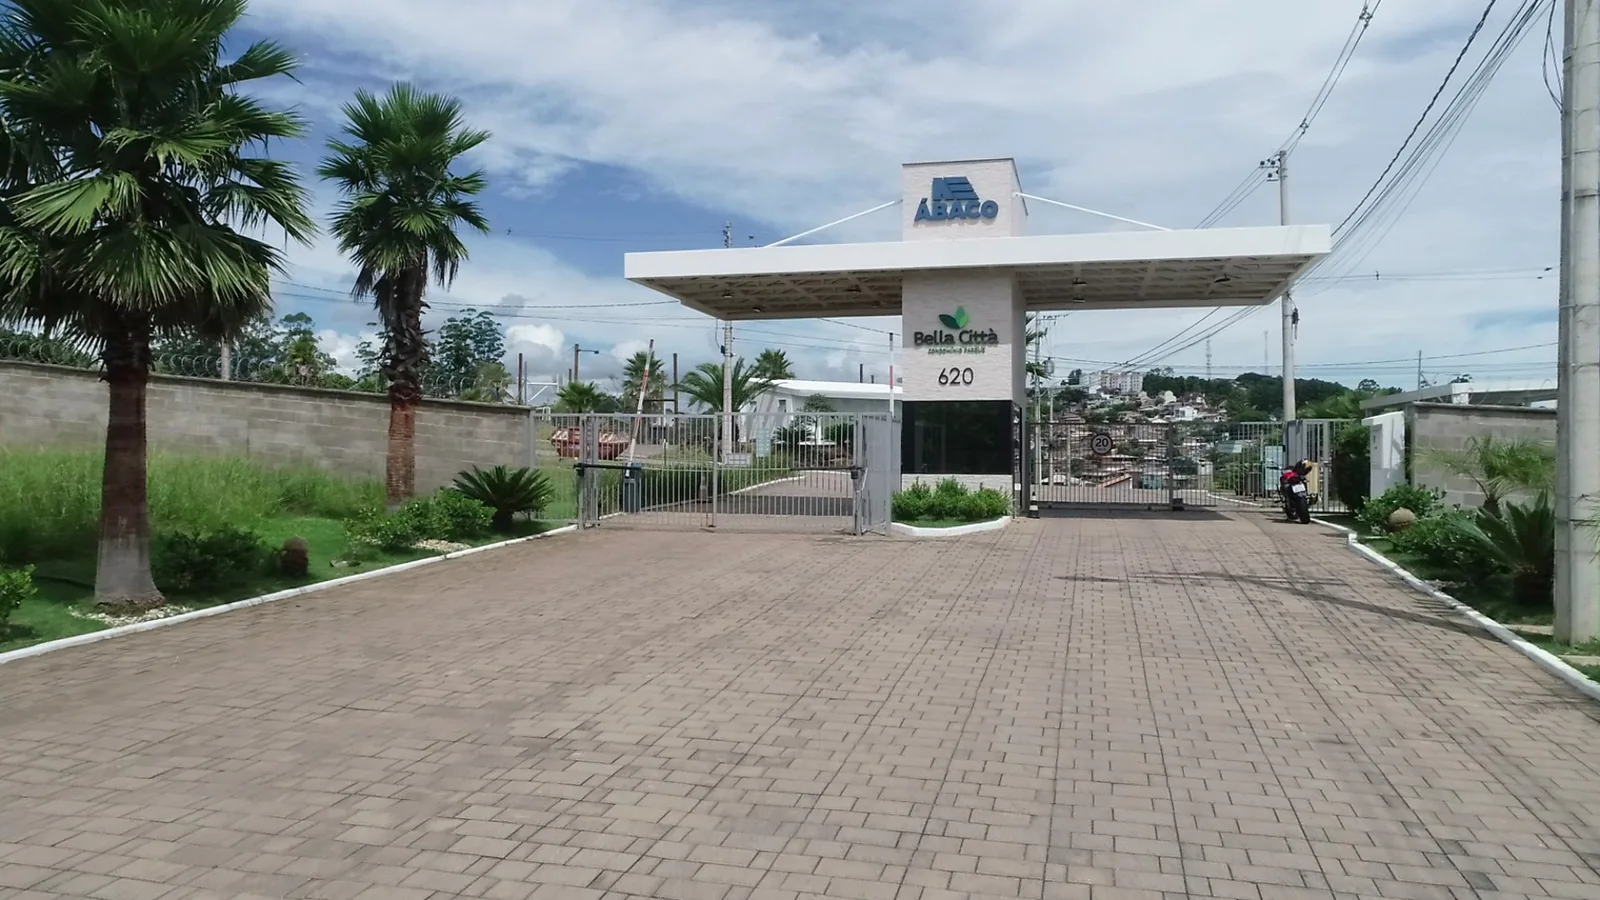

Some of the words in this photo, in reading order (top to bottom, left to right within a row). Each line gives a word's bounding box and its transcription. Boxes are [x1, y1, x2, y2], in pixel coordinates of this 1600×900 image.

[914, 198, 999, 221] ÁBACO
[914, 330, 955, 346] Bella
[959, 328, 999, 345] Città
[939, 367, 974, 385] 620
[1095, 438, 1109, 447] 20
